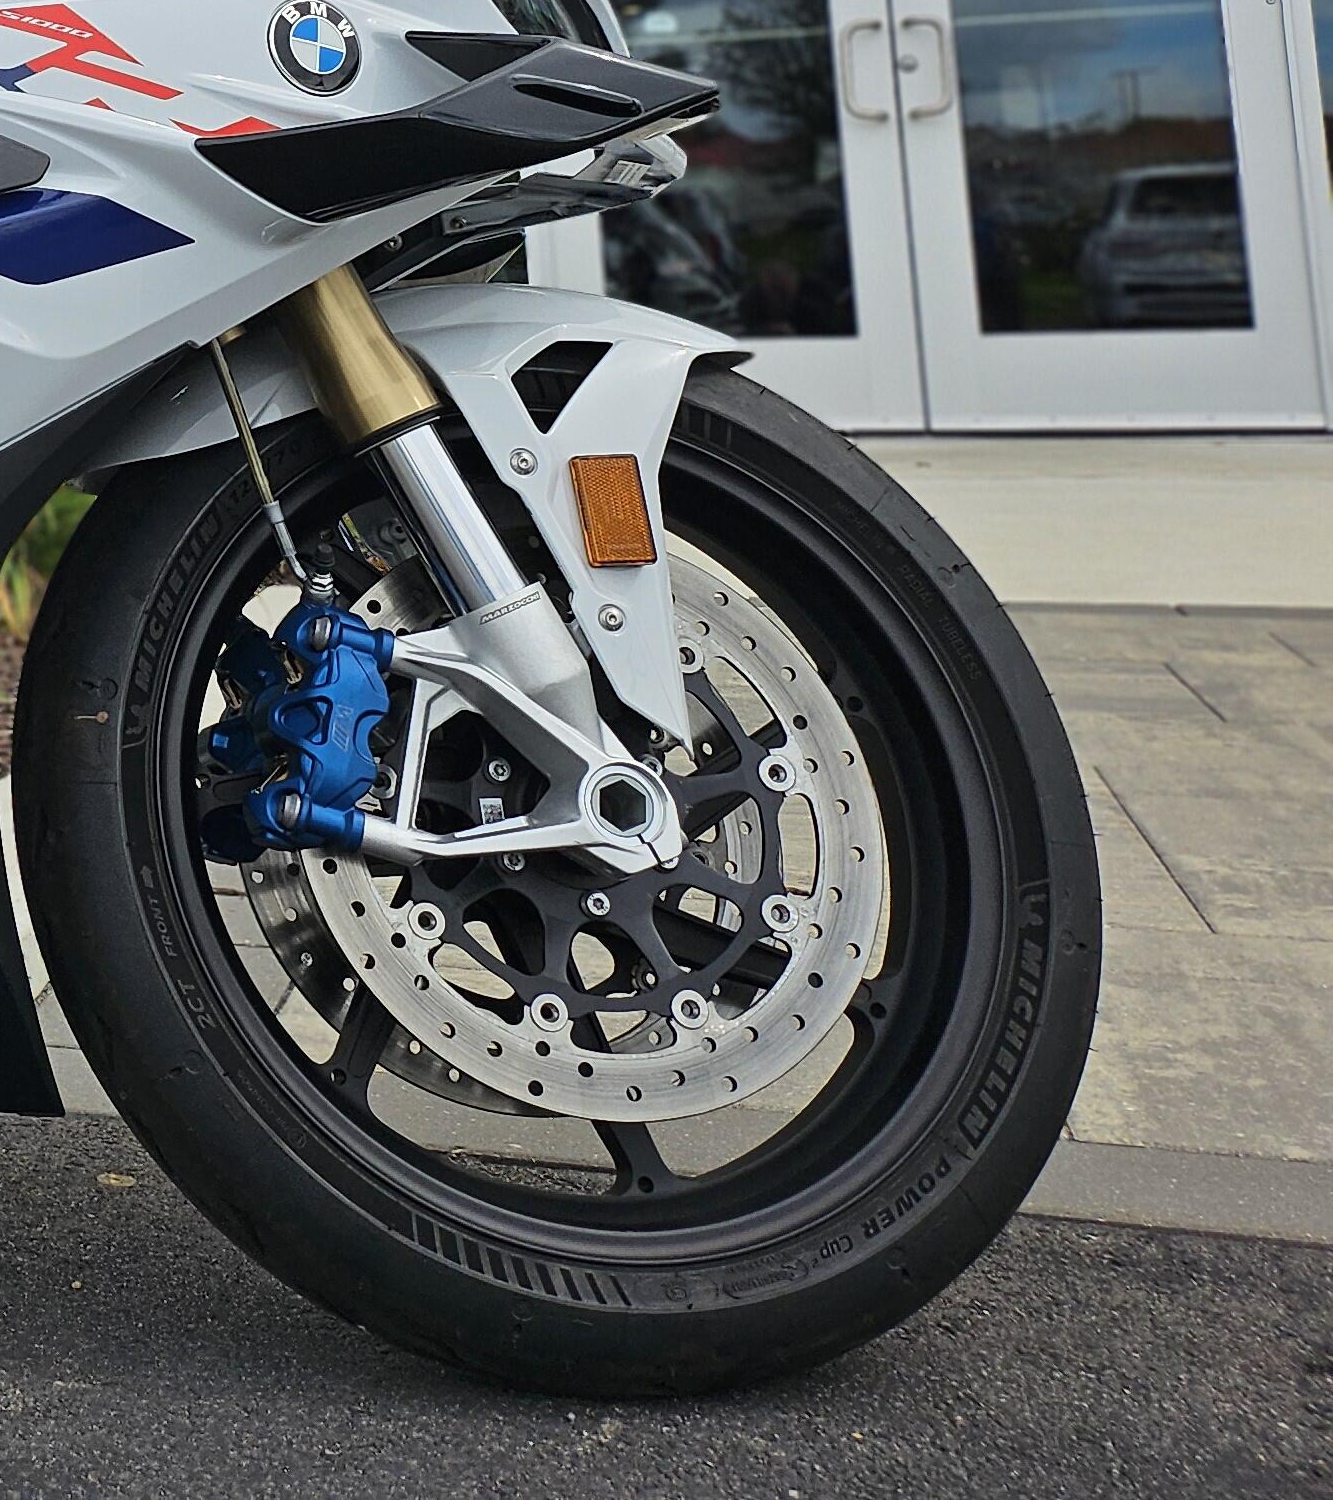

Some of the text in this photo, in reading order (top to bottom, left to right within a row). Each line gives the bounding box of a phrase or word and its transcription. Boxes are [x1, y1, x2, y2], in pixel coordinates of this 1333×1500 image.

[282, 1, 356, 39] BMW
[134, 512, 221, 692] MICHELIN
[962, 937, 1044, 1137] MICHELIN
[860, 1156, 952, 1240] POWER
